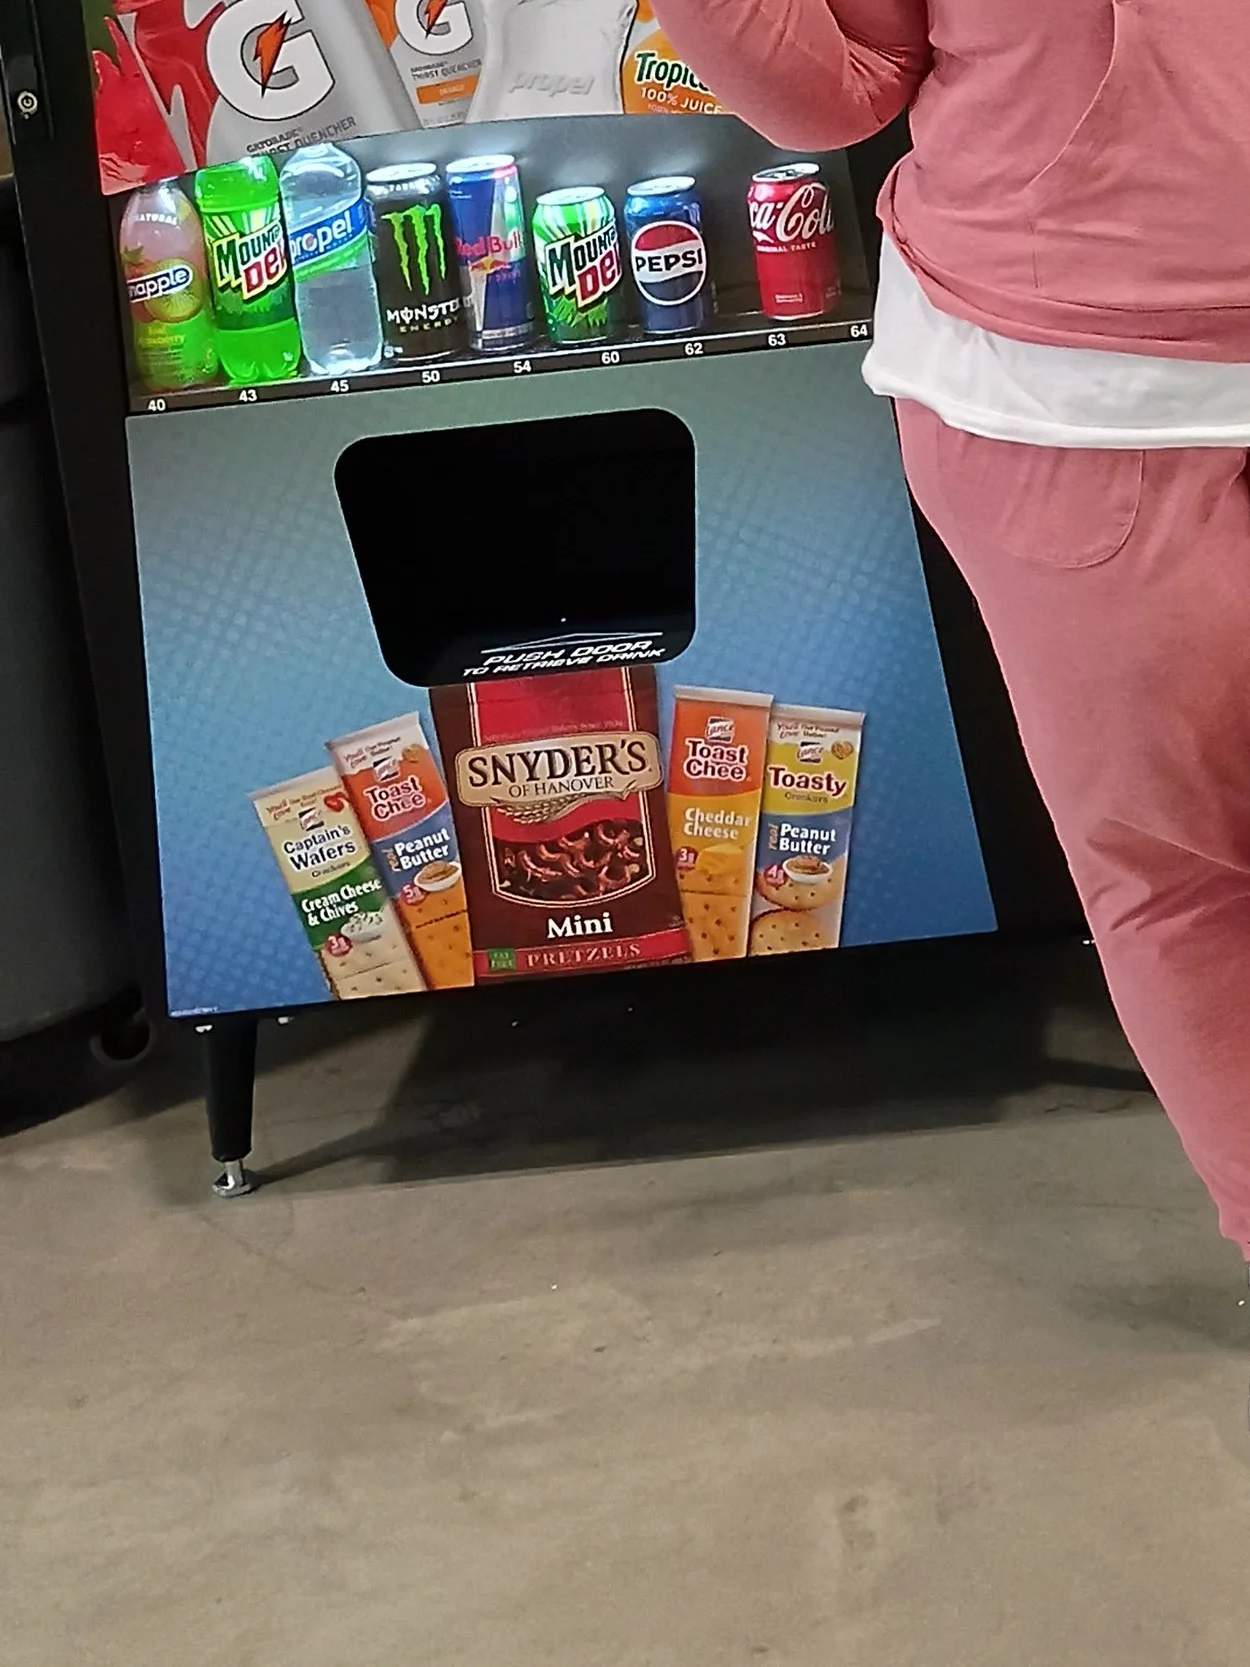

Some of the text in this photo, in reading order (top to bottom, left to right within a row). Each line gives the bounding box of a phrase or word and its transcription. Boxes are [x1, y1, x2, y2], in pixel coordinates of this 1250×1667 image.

[640, 87, 678, 106] 100%
[635, 249, 702, 272] PEPSI
[768, 333, 786, 347] 63
[850, 324, 868, 337] 64
[601, 351, 620, 365] 60
[685, 342, 704, 356] 62
[422, 371, 440, 383] 50
[513, 360, 531, 374] 54
[239, 389, 257, 402] 43
[330, 379, 349, 392] 45
[148, 399, 166, 412] 40
[462, 647, 666, 677] TO RETRIEVE DRINK
[483, 640, 653, 667] PUSH DOOR
[468, 738, 649, 788] SNYDER'S
[686, 740, 748, 763] Toast
[685, 759, 744, 781] Chee
[366, 778, 421, 804] Toast
[508, 774, 615, 798] OF HANOVER
[768, 766, 848, 798] Toasty
[684, 807, 751, 827] Cheddar
[283, 824, 352, 855] Captain's
[395, 828, 451, 856] Peanut
[683, 820, 740, 841] Cheese
[780, 823, 837, 842] Peanut
[290, 840, 356, 872] Wafers
[399, 844, 450, 872] Butter
[779, 837, 831, 856] Butter
[301, 878, 383, 915] Cream Cheese
[307, 901, 360, 927] & Chives
[547, 911, 614, 938] Mini
[526, 943, 642, 968] PRETZELS
